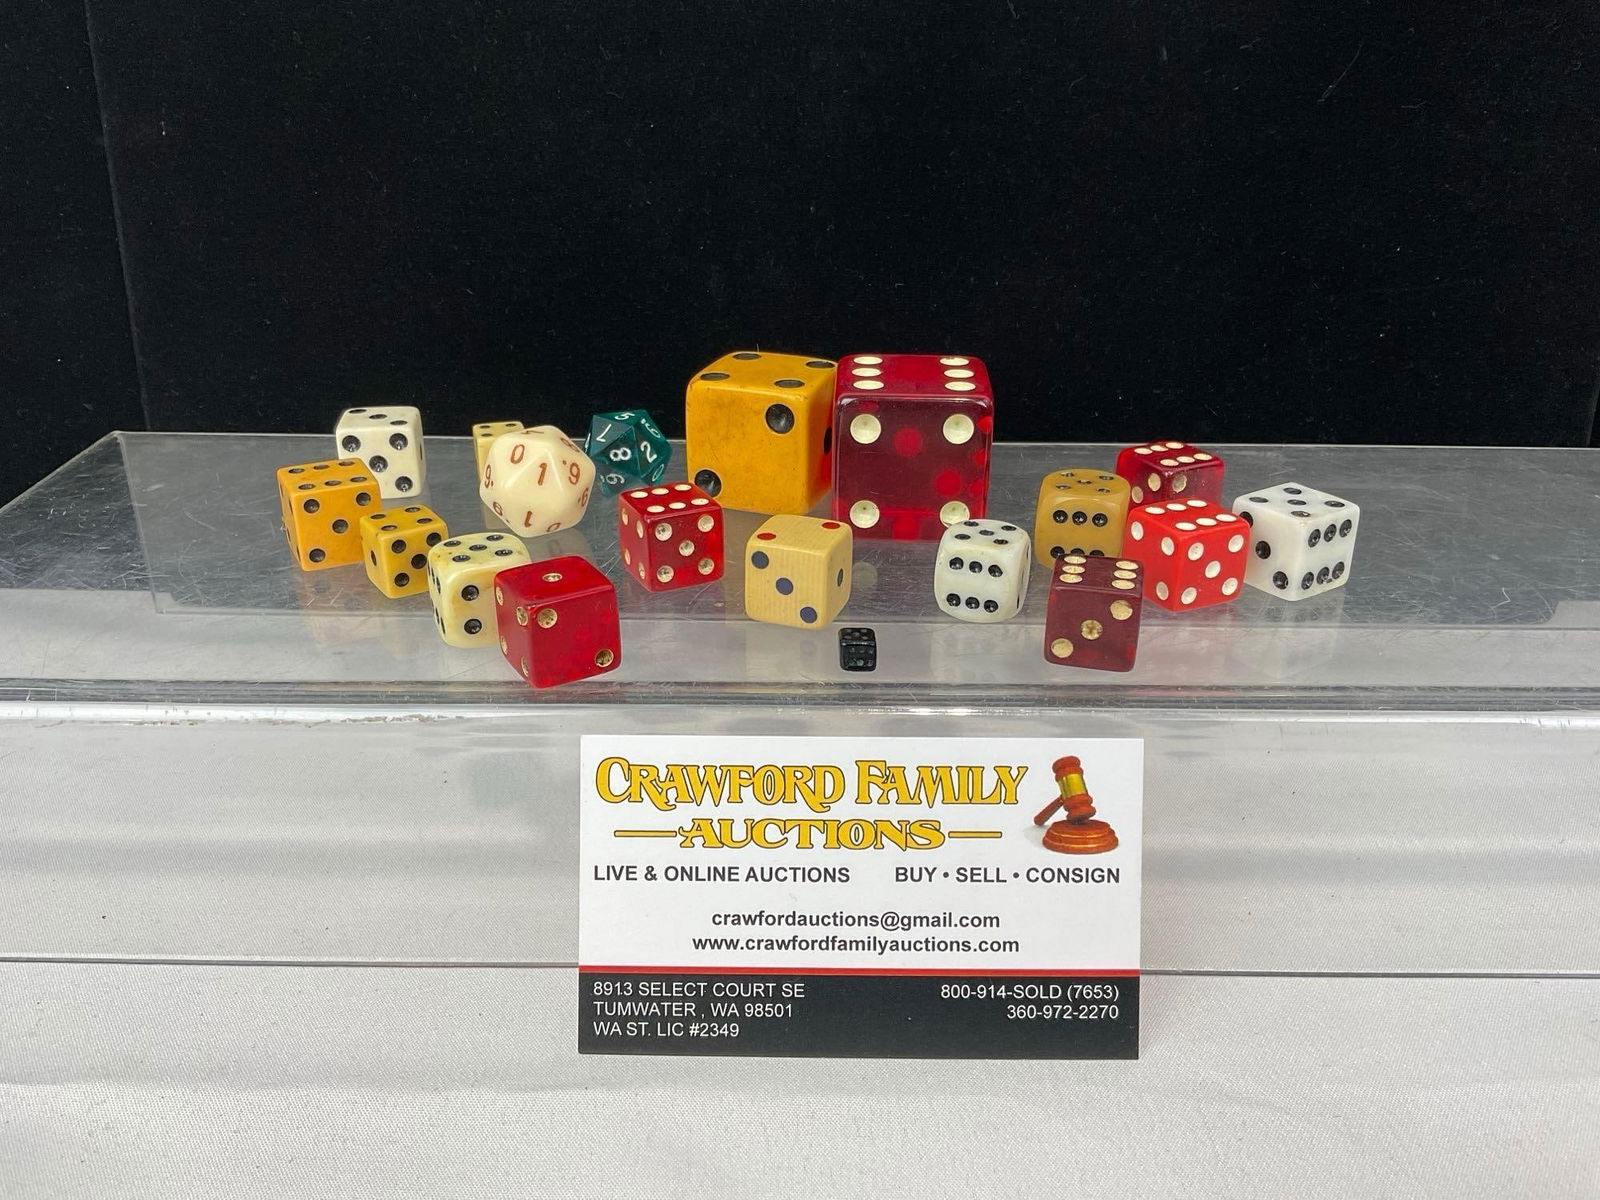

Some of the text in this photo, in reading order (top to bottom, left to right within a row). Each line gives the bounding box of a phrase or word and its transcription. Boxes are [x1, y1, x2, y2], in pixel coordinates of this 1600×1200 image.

[510, 444, 525, 464] 0
[609, 447, 631, 461] 8
[640, 441, 658, 463] 2
[537, 462, 547, 486] 1
[596, 757, 1029, 812] CRAWFORD FAMILY
[678, 818, 945, 851] AUCTIONS
[593, 864, 851, 884] LIVE & ONLINE AUCTIONS
[895, 866, 1120, 884] BUY SELL CONSIGN
[711, 909, 1000, 932] crawfordauctions@gmail.com
[691, 934, 1020, 956] www.crawfordfamilyauctions.com
[593, 980, 806, 998] 8913 SELECT COURT SE
[940, 984, 1120, 1003] 800-914-SOLD (7653)
[592, 1000, 697, 1017] TUMWATER
[710, 1002, 740, 1018] WA
[744, 1002, 792, 1018] 98501
[1006, 1004, 1119, 1020] 360-972-2270
[592, 1020, 740, 1038] WA ST. LIC #2349
